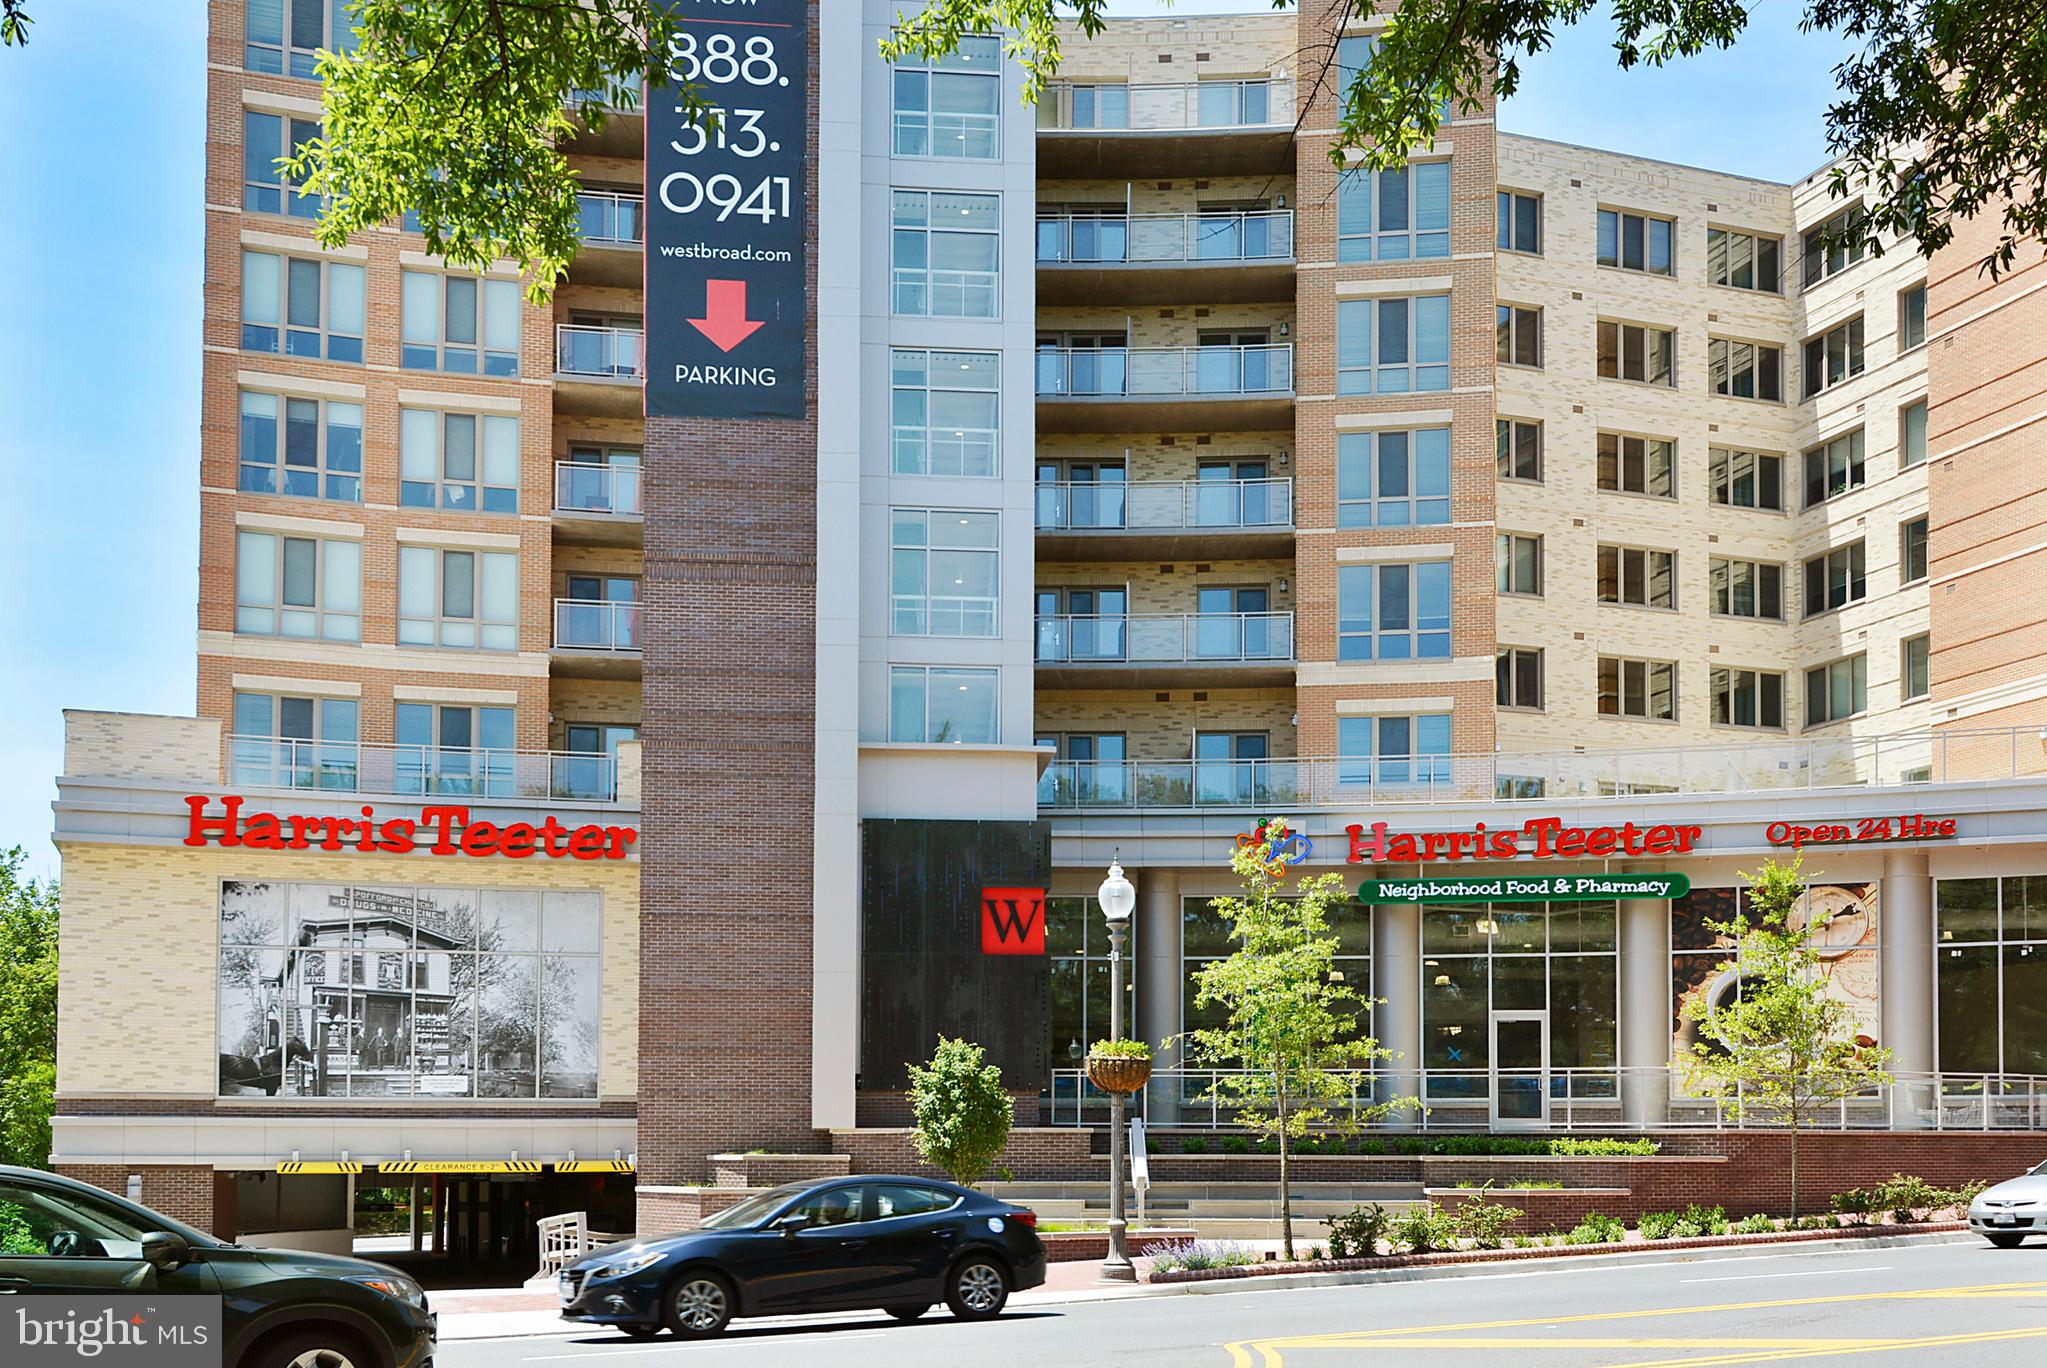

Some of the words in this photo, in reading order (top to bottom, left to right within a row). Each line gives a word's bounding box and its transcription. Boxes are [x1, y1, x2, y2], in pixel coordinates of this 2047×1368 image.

[667, 32, 790, 87] 888.
[659, 171, 790, 224] 0941
[660, 243, 791, 262] westbroad.com
[675, 364, 777, 386] PARKING
[183, 795, 416, 854] Harris
[421, 804, 637, 860] Teeter
[1345, 821, 1519, 864] Harris
[1524, 816, 1702, 859] Teeter
[1766, 821, 1852, 849] Open
[1856, 817, 1892, 841] 24
[1897, 814, 1957, 838] Hrs
[1378, 881, 1503, 900] Neighborhood
[1506, 880, 1549, 895] Food
[1553, 878, 1572, 893] &
[1576, 879, 1671, 896] Pharmacy
[340, 898, 376, 911] DUGS
[392, 905, 438, 919] MEDCINE
[984, 899, 1042, 944] W
[423, 1163, 478, 1171] CLEARANCE
